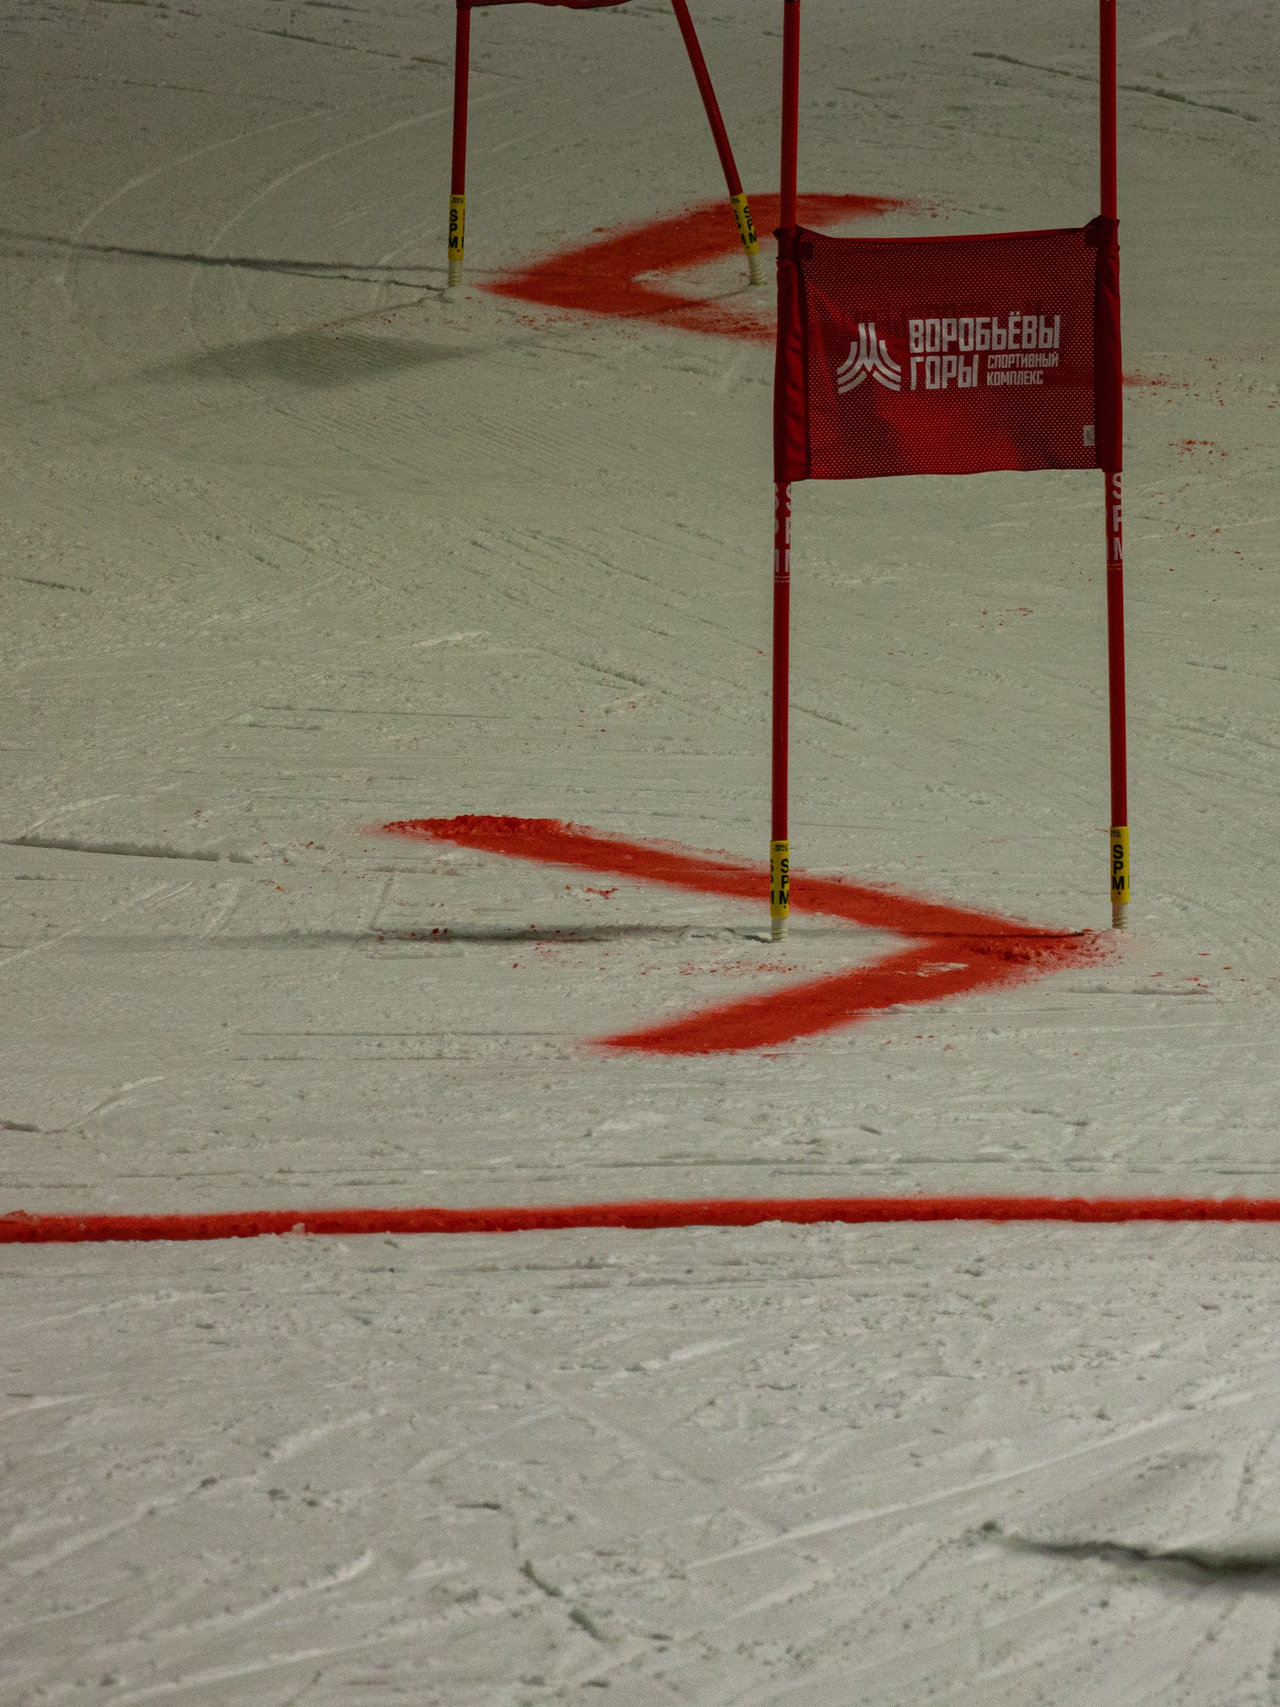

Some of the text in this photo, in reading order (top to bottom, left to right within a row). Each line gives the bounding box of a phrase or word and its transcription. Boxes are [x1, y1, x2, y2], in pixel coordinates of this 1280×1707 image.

[908, 310, 1061, 354] ВОРОБЬЁВЫ
[910, 354, 979, 391] ГОРЫ
[986, 370, 1044, 387] КОМПЛЕКС
[987, 352, 1059, 369] СПОРТИВНЫЙ
[1111, 844, 1125, 891] SPM
